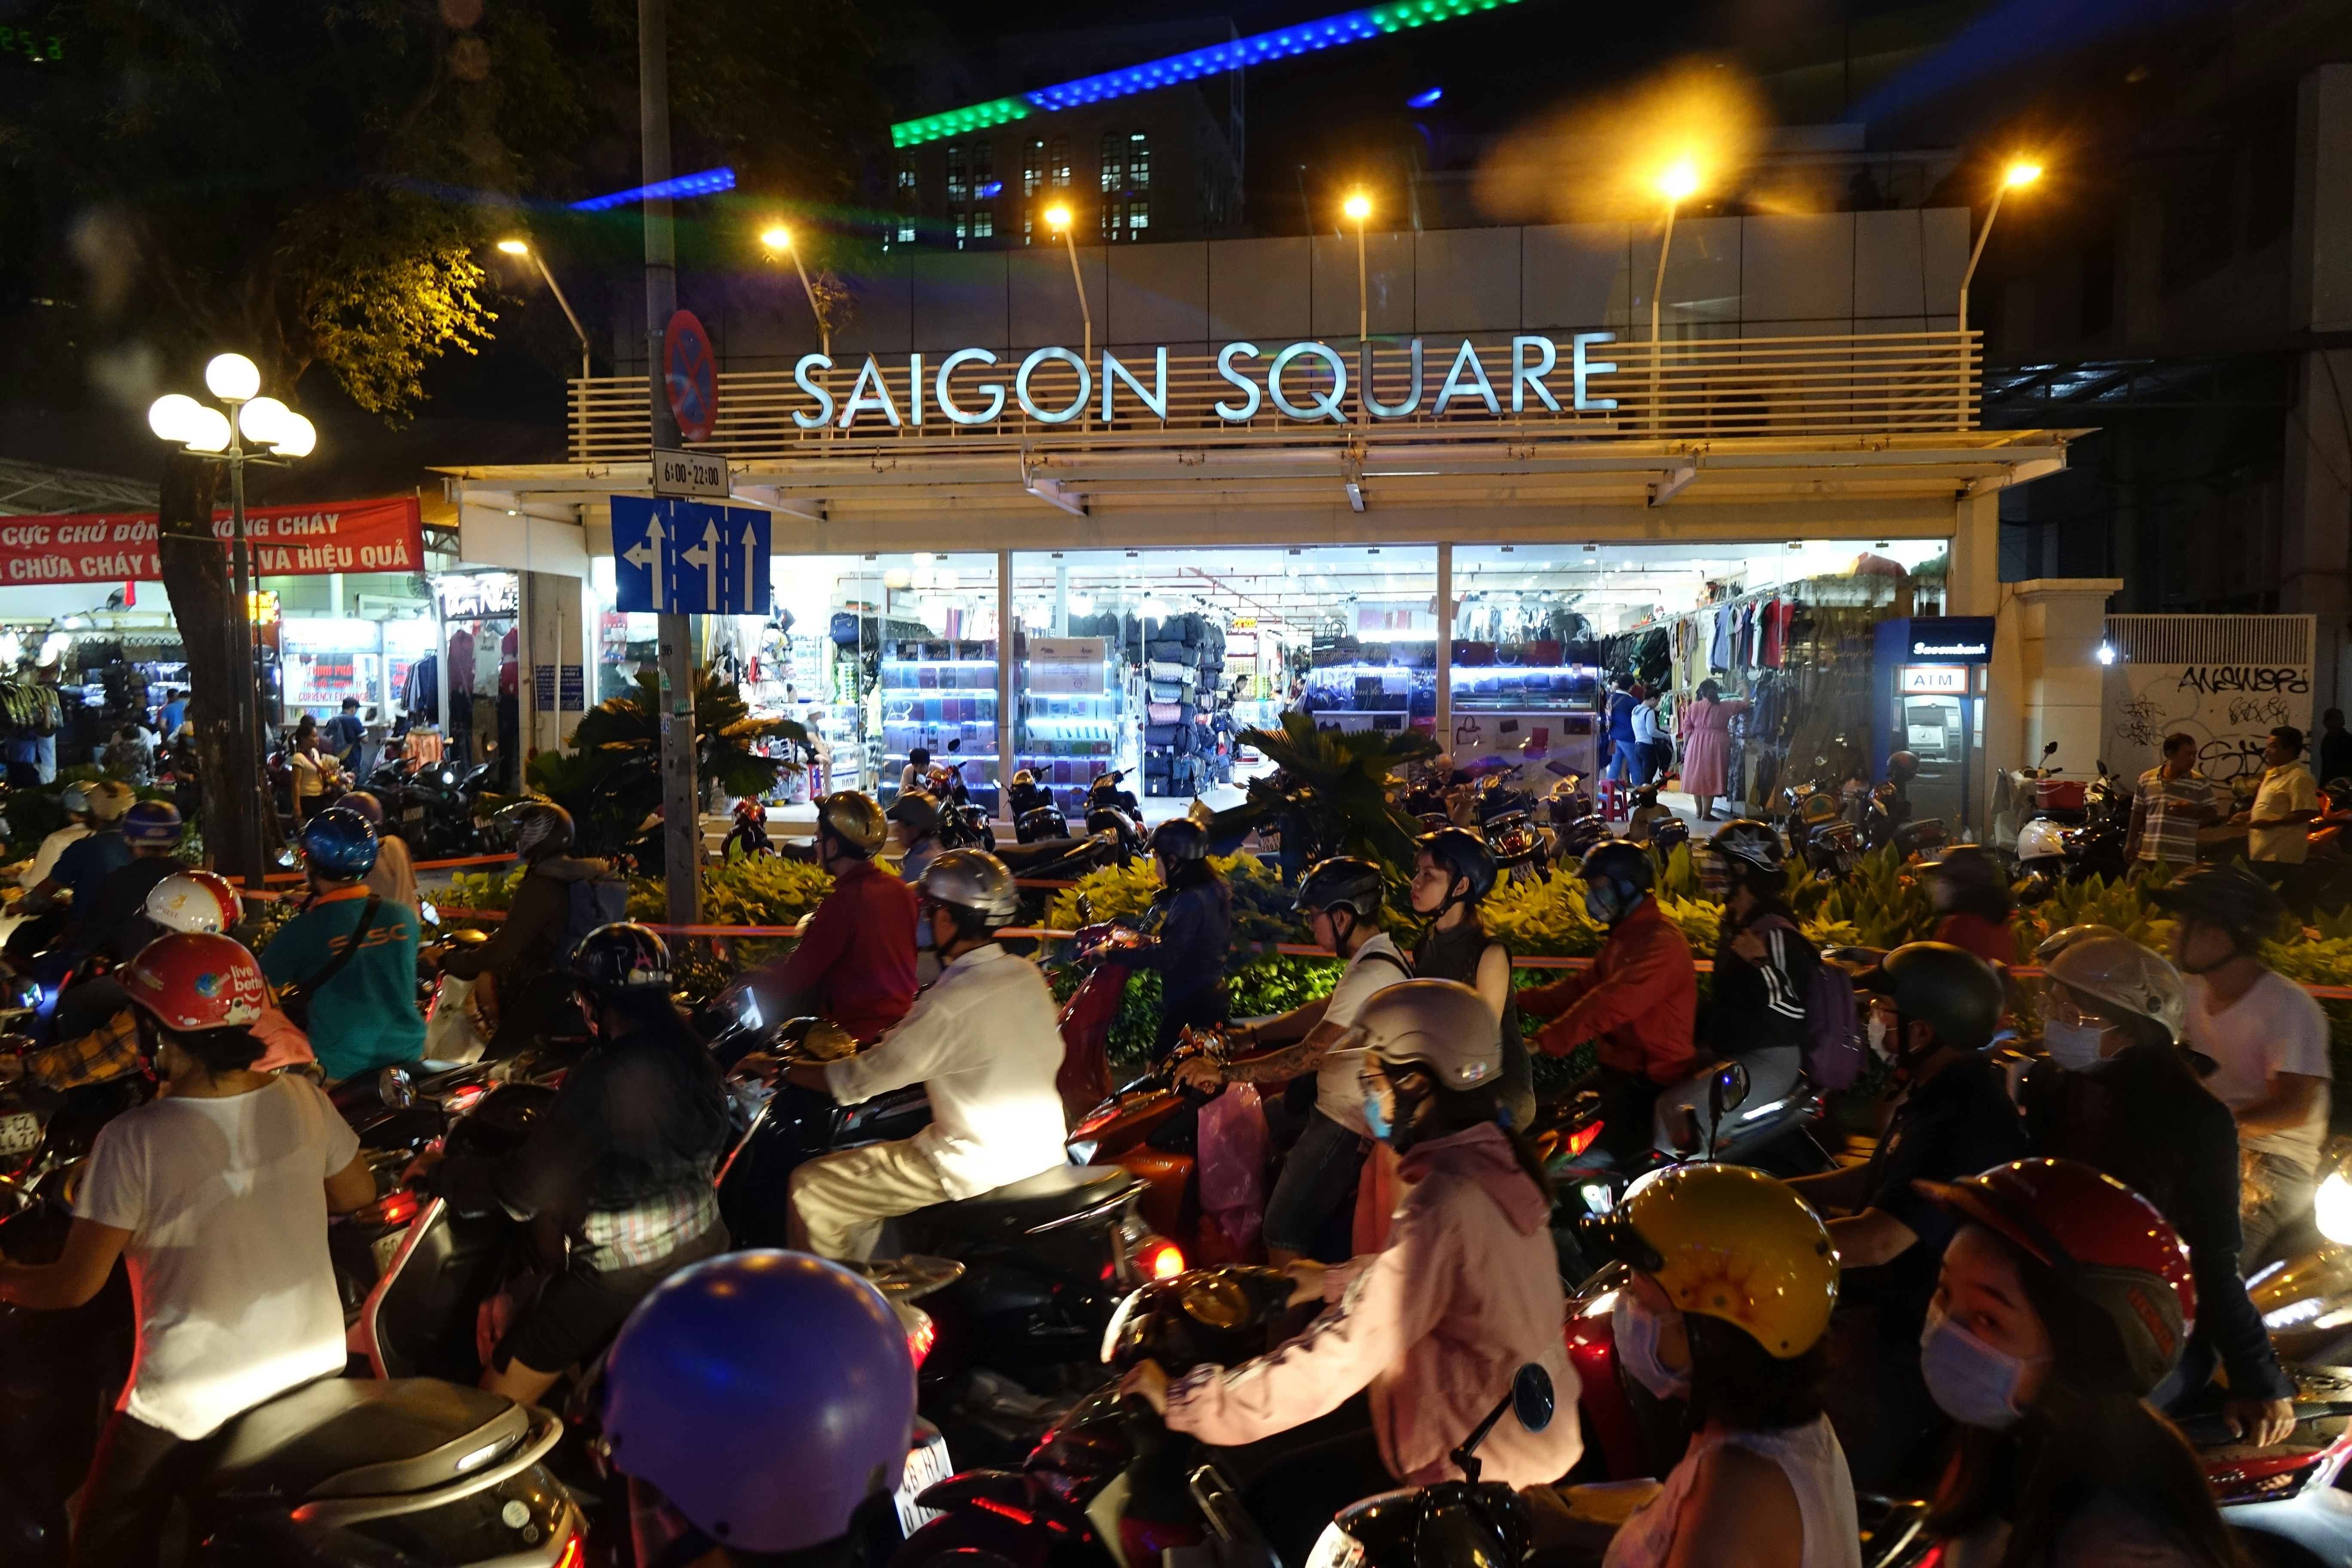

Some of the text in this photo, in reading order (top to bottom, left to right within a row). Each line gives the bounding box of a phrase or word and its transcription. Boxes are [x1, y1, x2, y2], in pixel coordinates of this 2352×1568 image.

[791, 332, 1618, 429] SAIGON SQUARE
[2, 525, 51, 549] CỰC
[58, 519, 107, 544] CHỦ
[113, 520, 159, 545] ĐỘN
[277, 513, 339, 536] CHÁY
[9, 554, 75, 579] CHỮA
[80, 551, 143, 576] CHÁY
[259, 547, 292, 571] VÀ
[297, 543, 353, 572] HIỆU
[361, 539, 409, 568] QUẢ
[1914, 675, 1952, 685] ATM
[299, 692, 332, 701] CURRENCY
[842, 777, 856, 788] RADO
[230, 965, 254, 978] live
